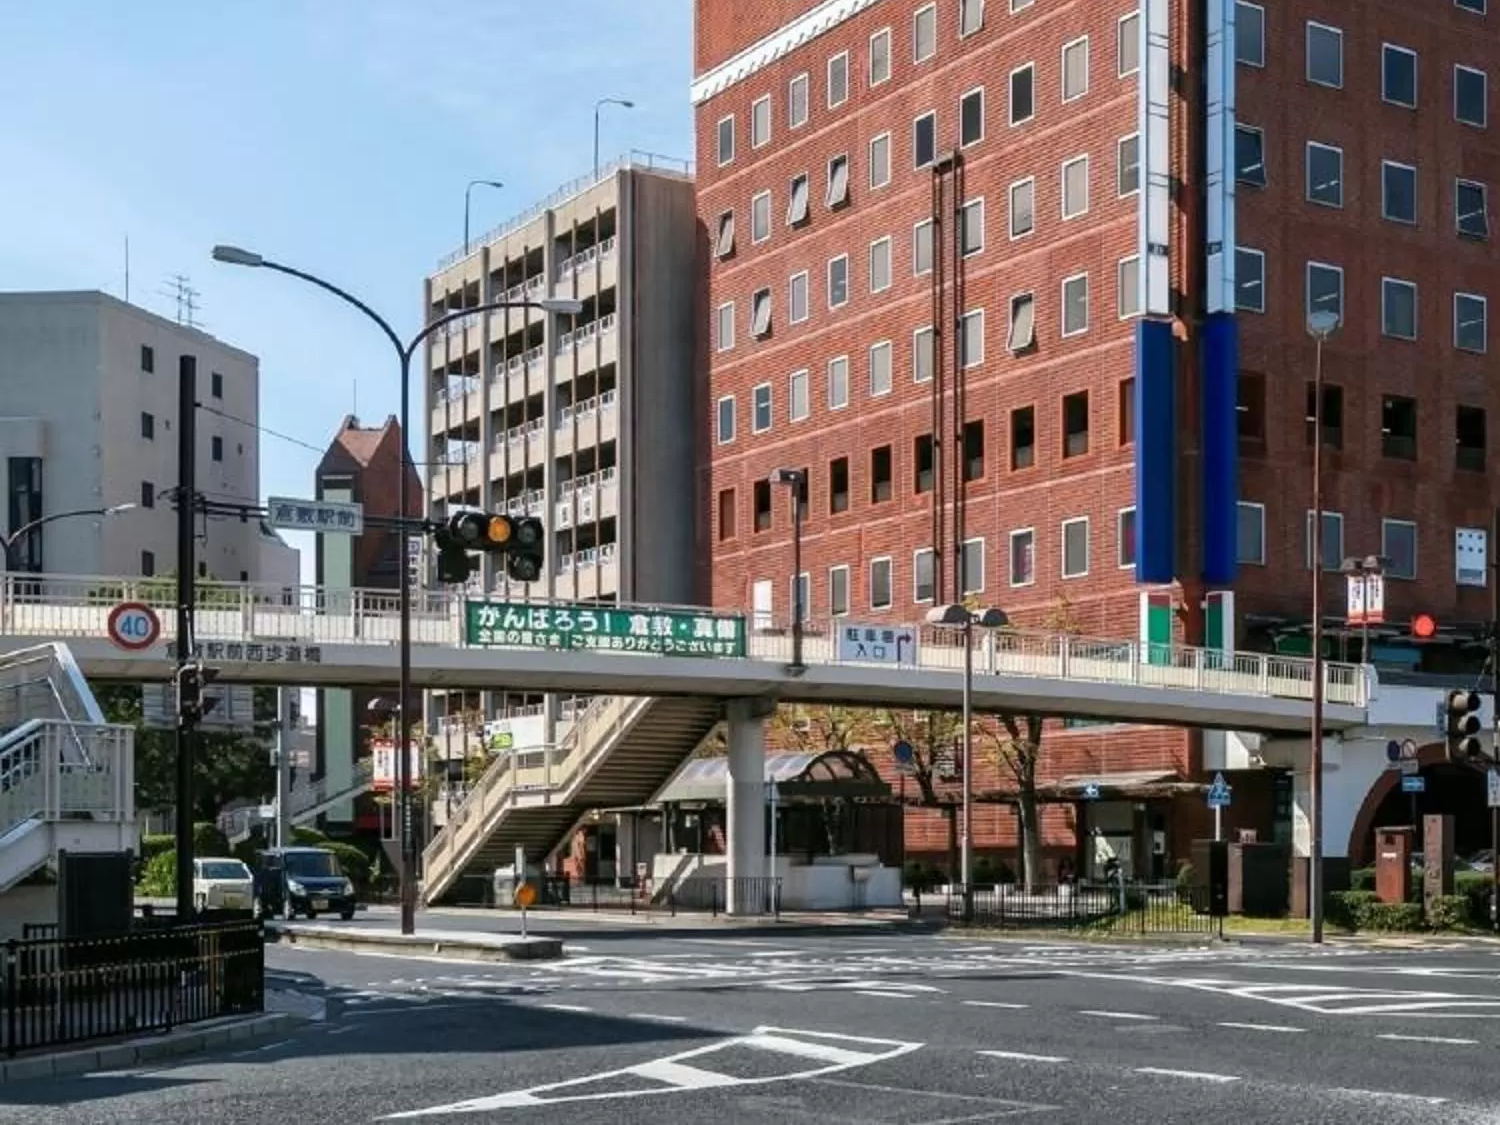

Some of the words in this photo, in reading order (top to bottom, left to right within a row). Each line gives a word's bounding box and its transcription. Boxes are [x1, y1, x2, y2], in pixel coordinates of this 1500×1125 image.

[275, 504, 354, 528] 倉敷駅前
[120, 615, 150, 637] 40
[855, 643, 886, 660] 入口
